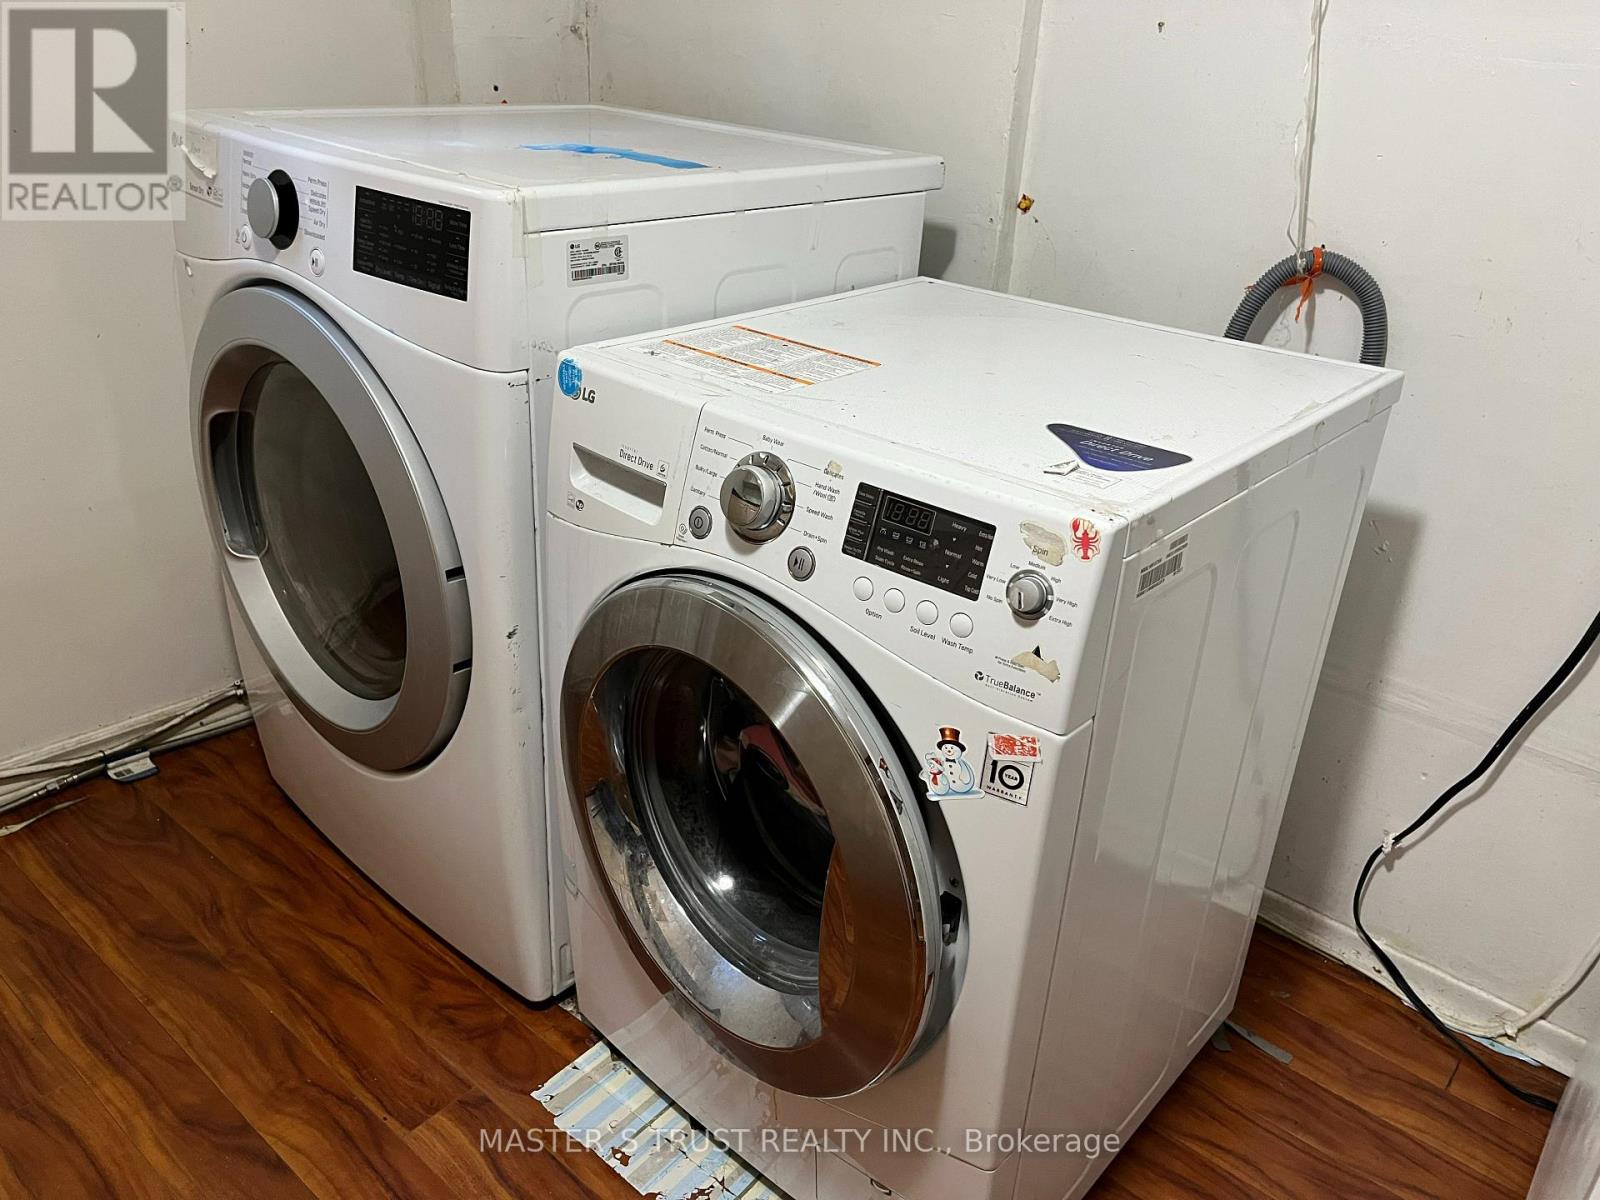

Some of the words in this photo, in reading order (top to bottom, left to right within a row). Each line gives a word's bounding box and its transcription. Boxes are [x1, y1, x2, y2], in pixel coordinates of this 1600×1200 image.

[582, 387, 596, 404] LG
[620, 448, 637, 464] Direct
[638, 456, 654, 471] Drive
[823, 468, 845, 480] Delicates
[814, 482, 827, 491] Hand
[827, 484, 841, 495] Wash
[806, 506, 820, 517] Speed
[820, 511, 833, 521] Wash
[952, 521, 968, 532] Heavy
[944, 548, 962, 560] Normal
[1032, 545, 1049, 557] Spin
[1009, 562, 1020, 570] Low
[1028, 560, 1046, 571] Medium
[937, 575, 950, 585] Light
[1050, 576, 1061, 585] High
[1056, 596, 1067, 606] Very
[1066, 600, 1078, 609] High
[865, 607, 883, 620] Option
[1048, 615, 1062, 624] Extra
[1061, 618, 1073, 628] High
[909, 625, 920, 635] Soil
[920, 629, 936, 641] Level
[941, 636, 957, 649] Wash
[957, 642, 974, 655] Temp
[990, 759, 1024, 791] 10
[1004, 772, 1018, 782] YEAR
[986, 784, 1022, 800] WARRANTY
